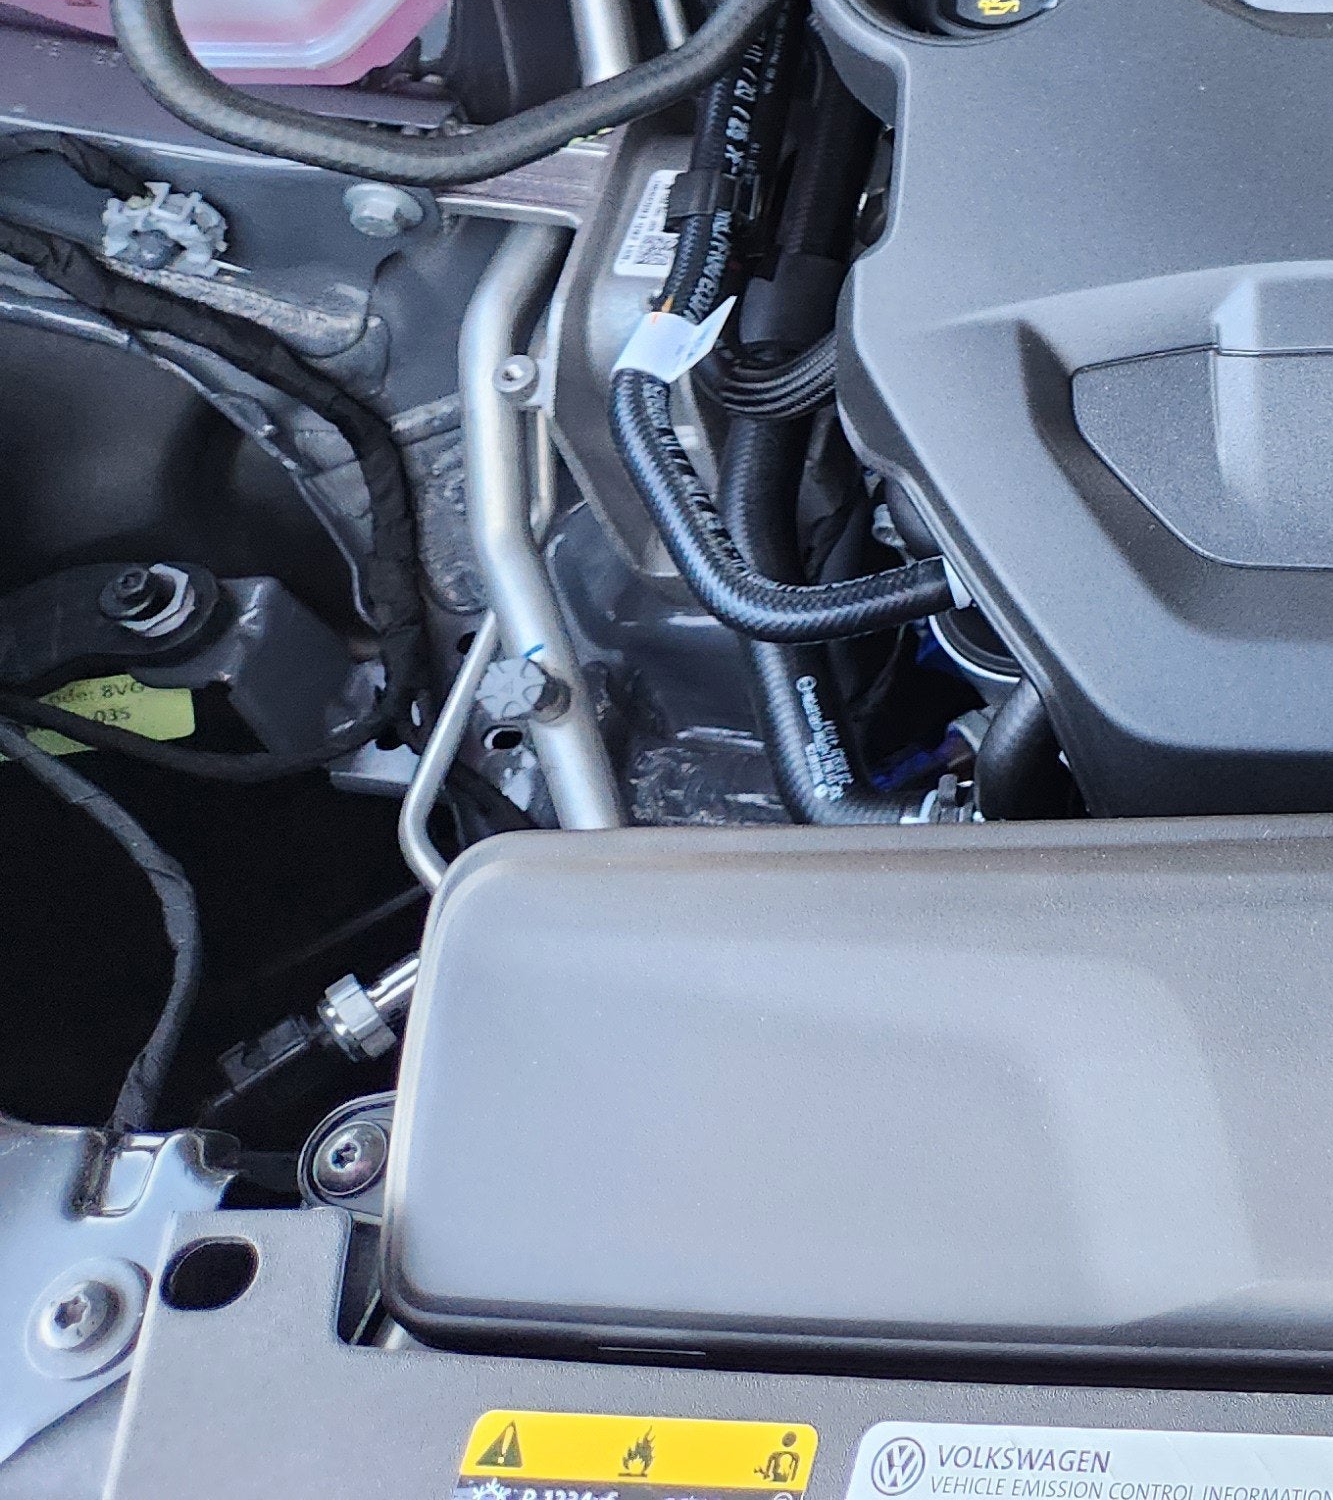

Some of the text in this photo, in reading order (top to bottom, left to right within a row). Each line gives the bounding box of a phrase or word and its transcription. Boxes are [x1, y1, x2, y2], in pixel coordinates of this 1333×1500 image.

[937, 1444, 1111, 1474] VOLKSWAGEN
[930, 1475, 1007, 1496] VEHICLE
[1011, 1478, 1104, 1499] EMISSION
[1108, 1482, 1195, 1500] CONTROL
